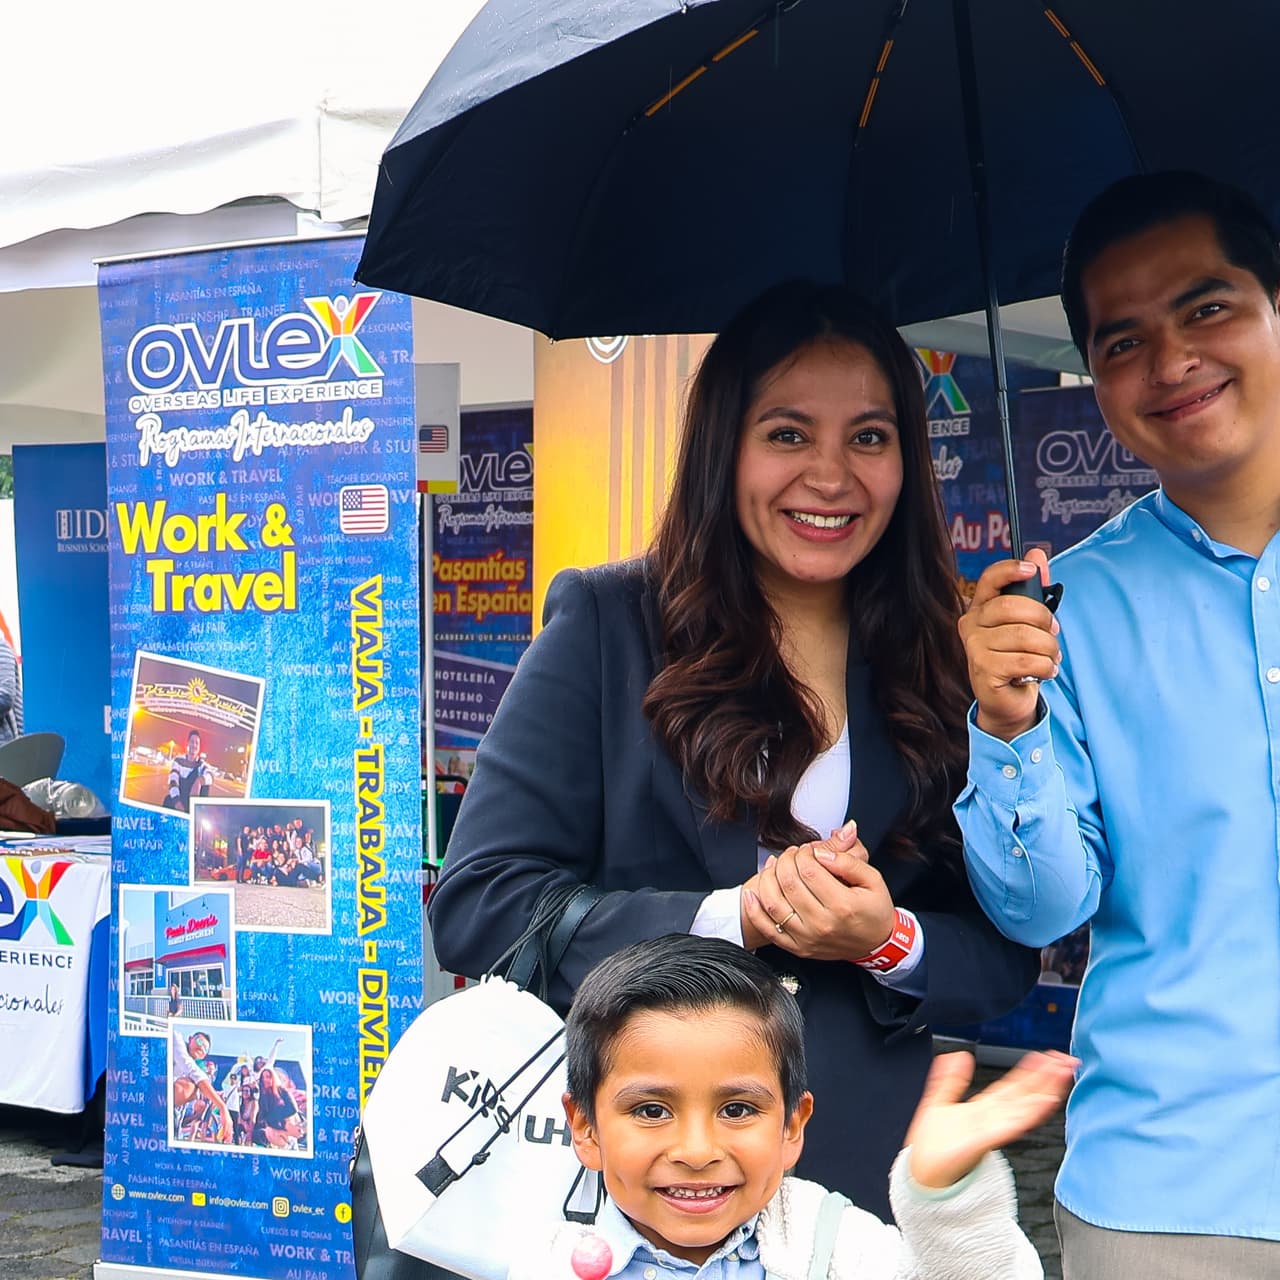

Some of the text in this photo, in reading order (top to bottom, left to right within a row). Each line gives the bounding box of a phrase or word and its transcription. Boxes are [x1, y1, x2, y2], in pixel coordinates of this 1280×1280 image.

[131, 382, 381, 411] OVERSEAS LIFE EXPERIENCE
[136, 407, 375, 467] Programas Internacionales
[169, 471, 216, 487] WORK
[218, 470, 228, 485] &
[231, 468, 283, 484] TRAVEL
[115, 492, 296, 556] Work &
[952, 515, 982, 550] Au
[145, 549, 298, 613] Travel
[351, 574, 384, 711] VIAJA
[434, 670, 496, 685] HOTELERÍA
[434, 690, 484, 703] TURISMO
[354, 743, 387, 937] TRABAJA
[128, 1189, 185, 1203] www.ovlex.com
[208, 1196, 269, 1211] info@ovlex.com
[292, 1204, 326, 1217] ovlex_ec
[269, 1243, 316, 1261] WORK
[320, 1248, 331, 1262] &
[286, 1269, 302, 1280] AU
